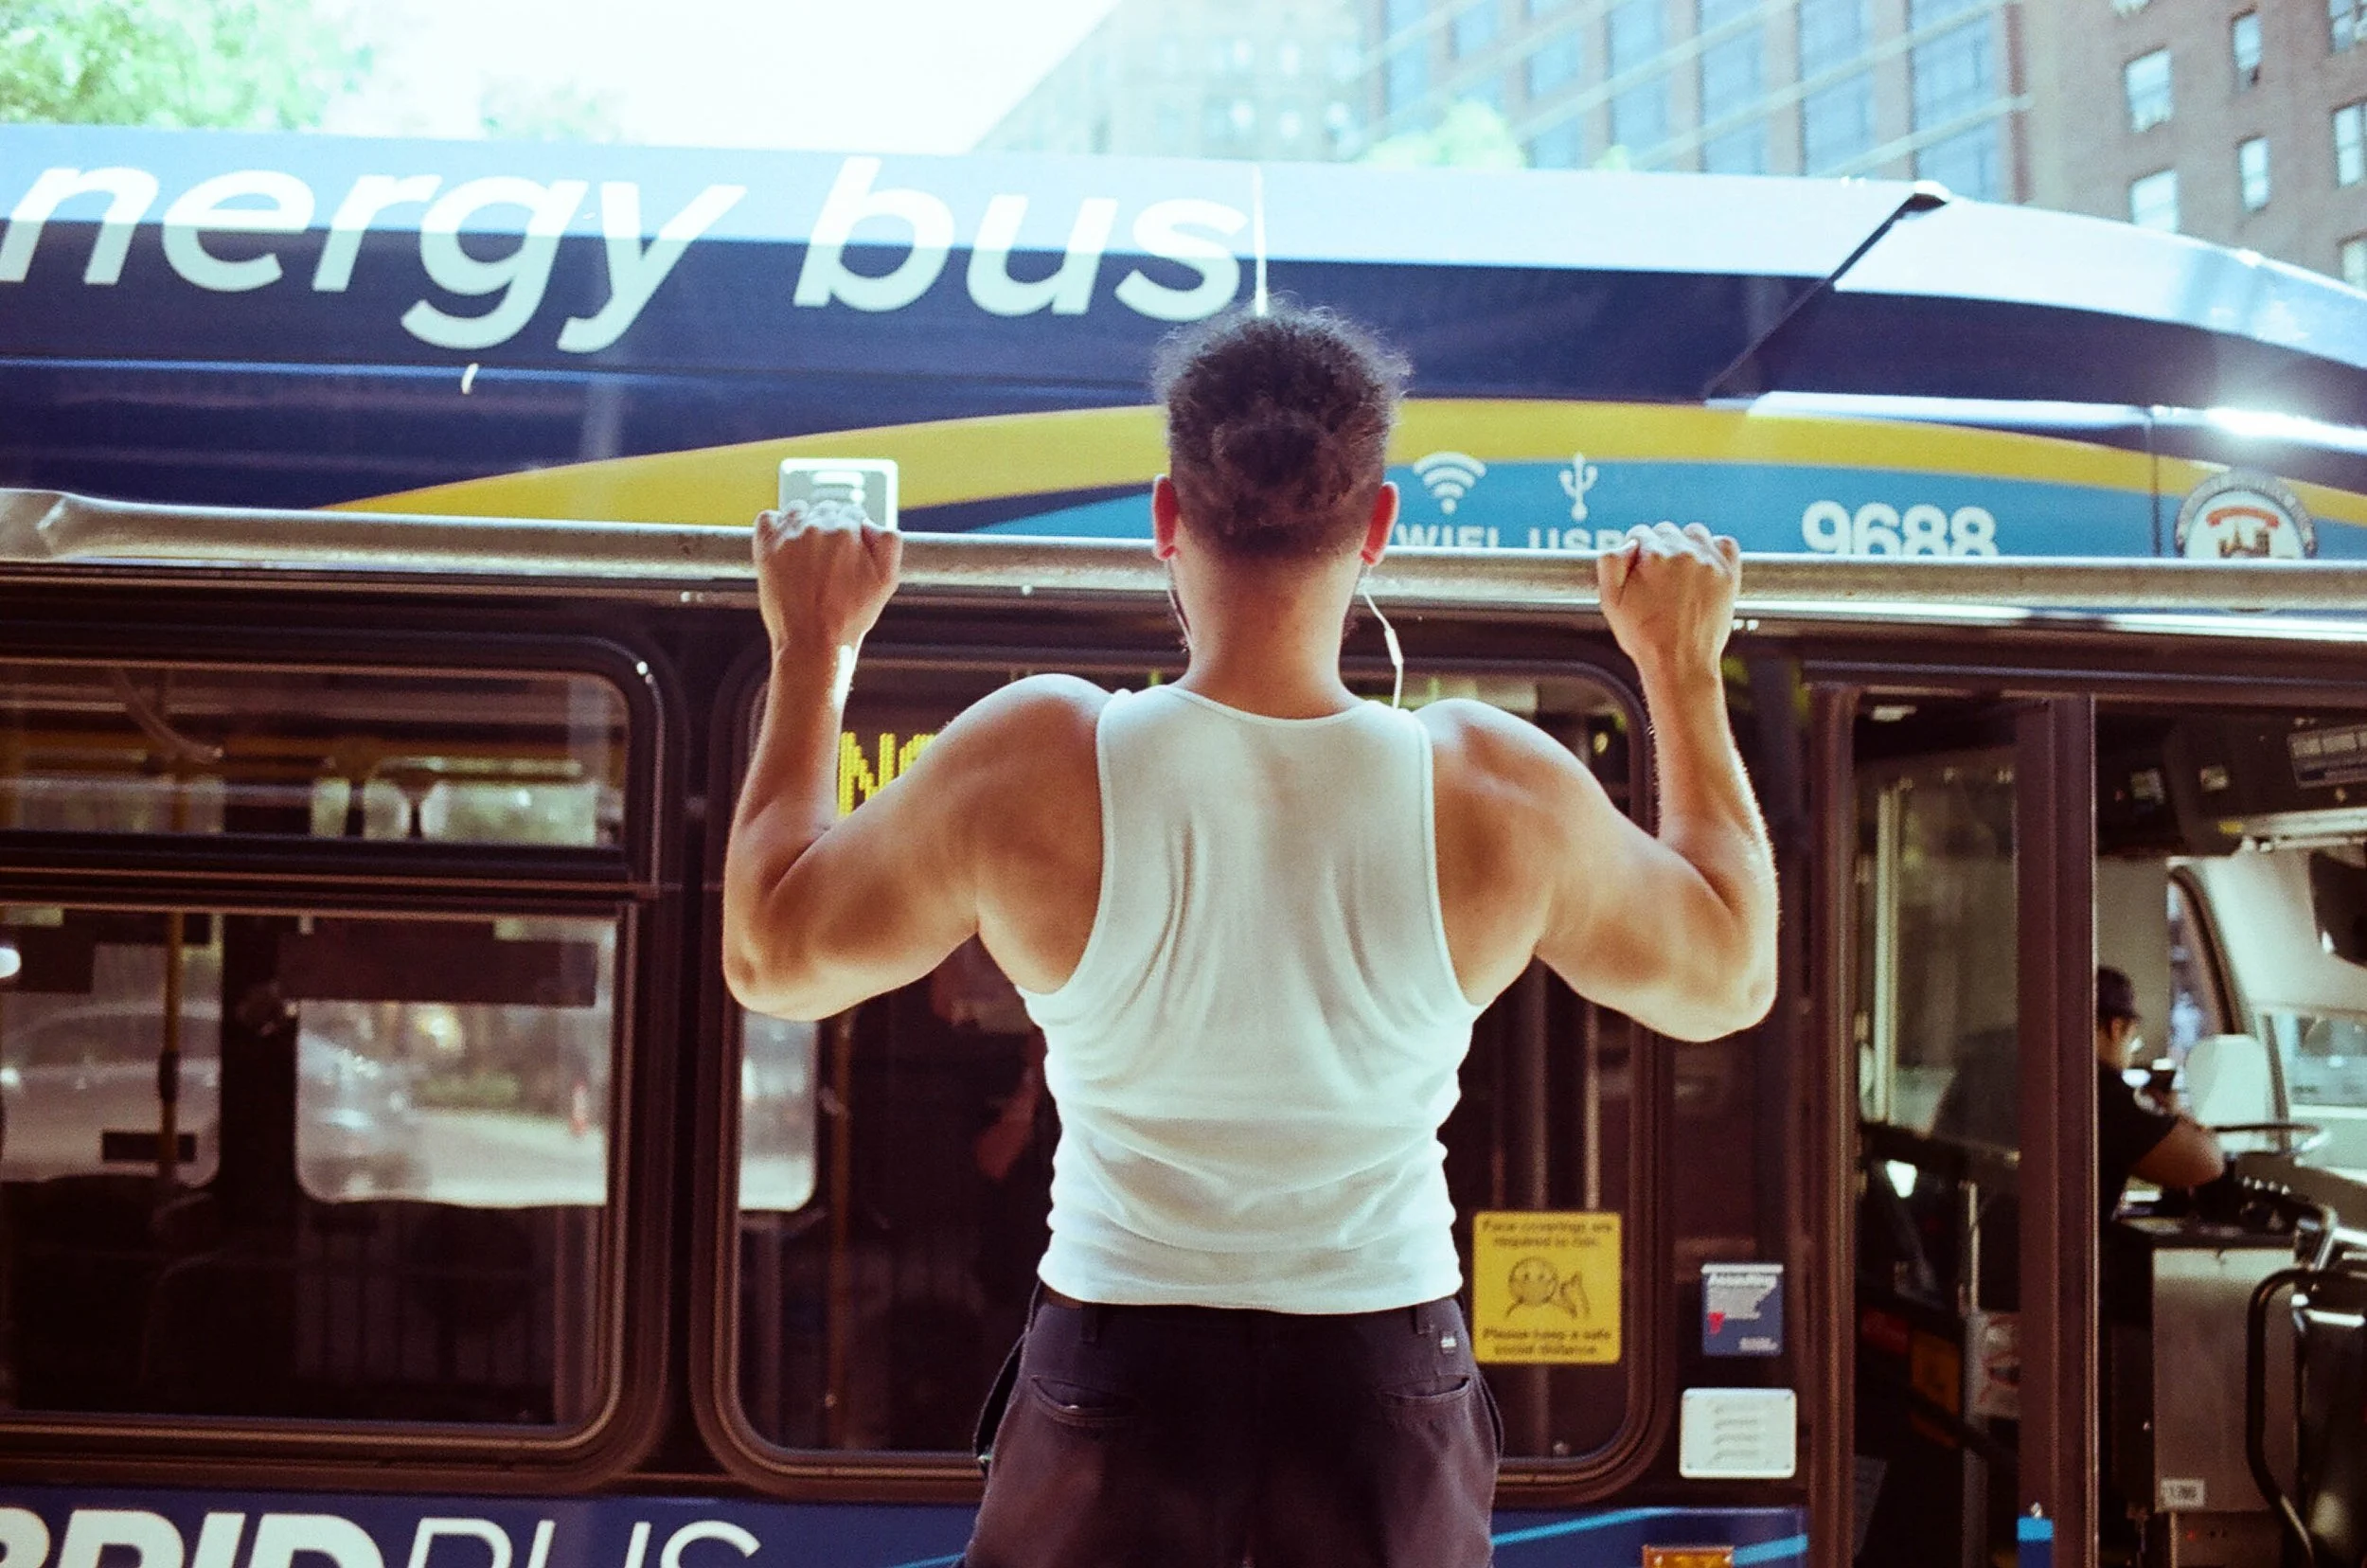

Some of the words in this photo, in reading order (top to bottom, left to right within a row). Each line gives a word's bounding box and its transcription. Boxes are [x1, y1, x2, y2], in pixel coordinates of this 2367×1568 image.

[0, 168, 748, 354] nergy
[792, 156, 1249, 323] bus
[1801, 499, 2000, 556] 9688
